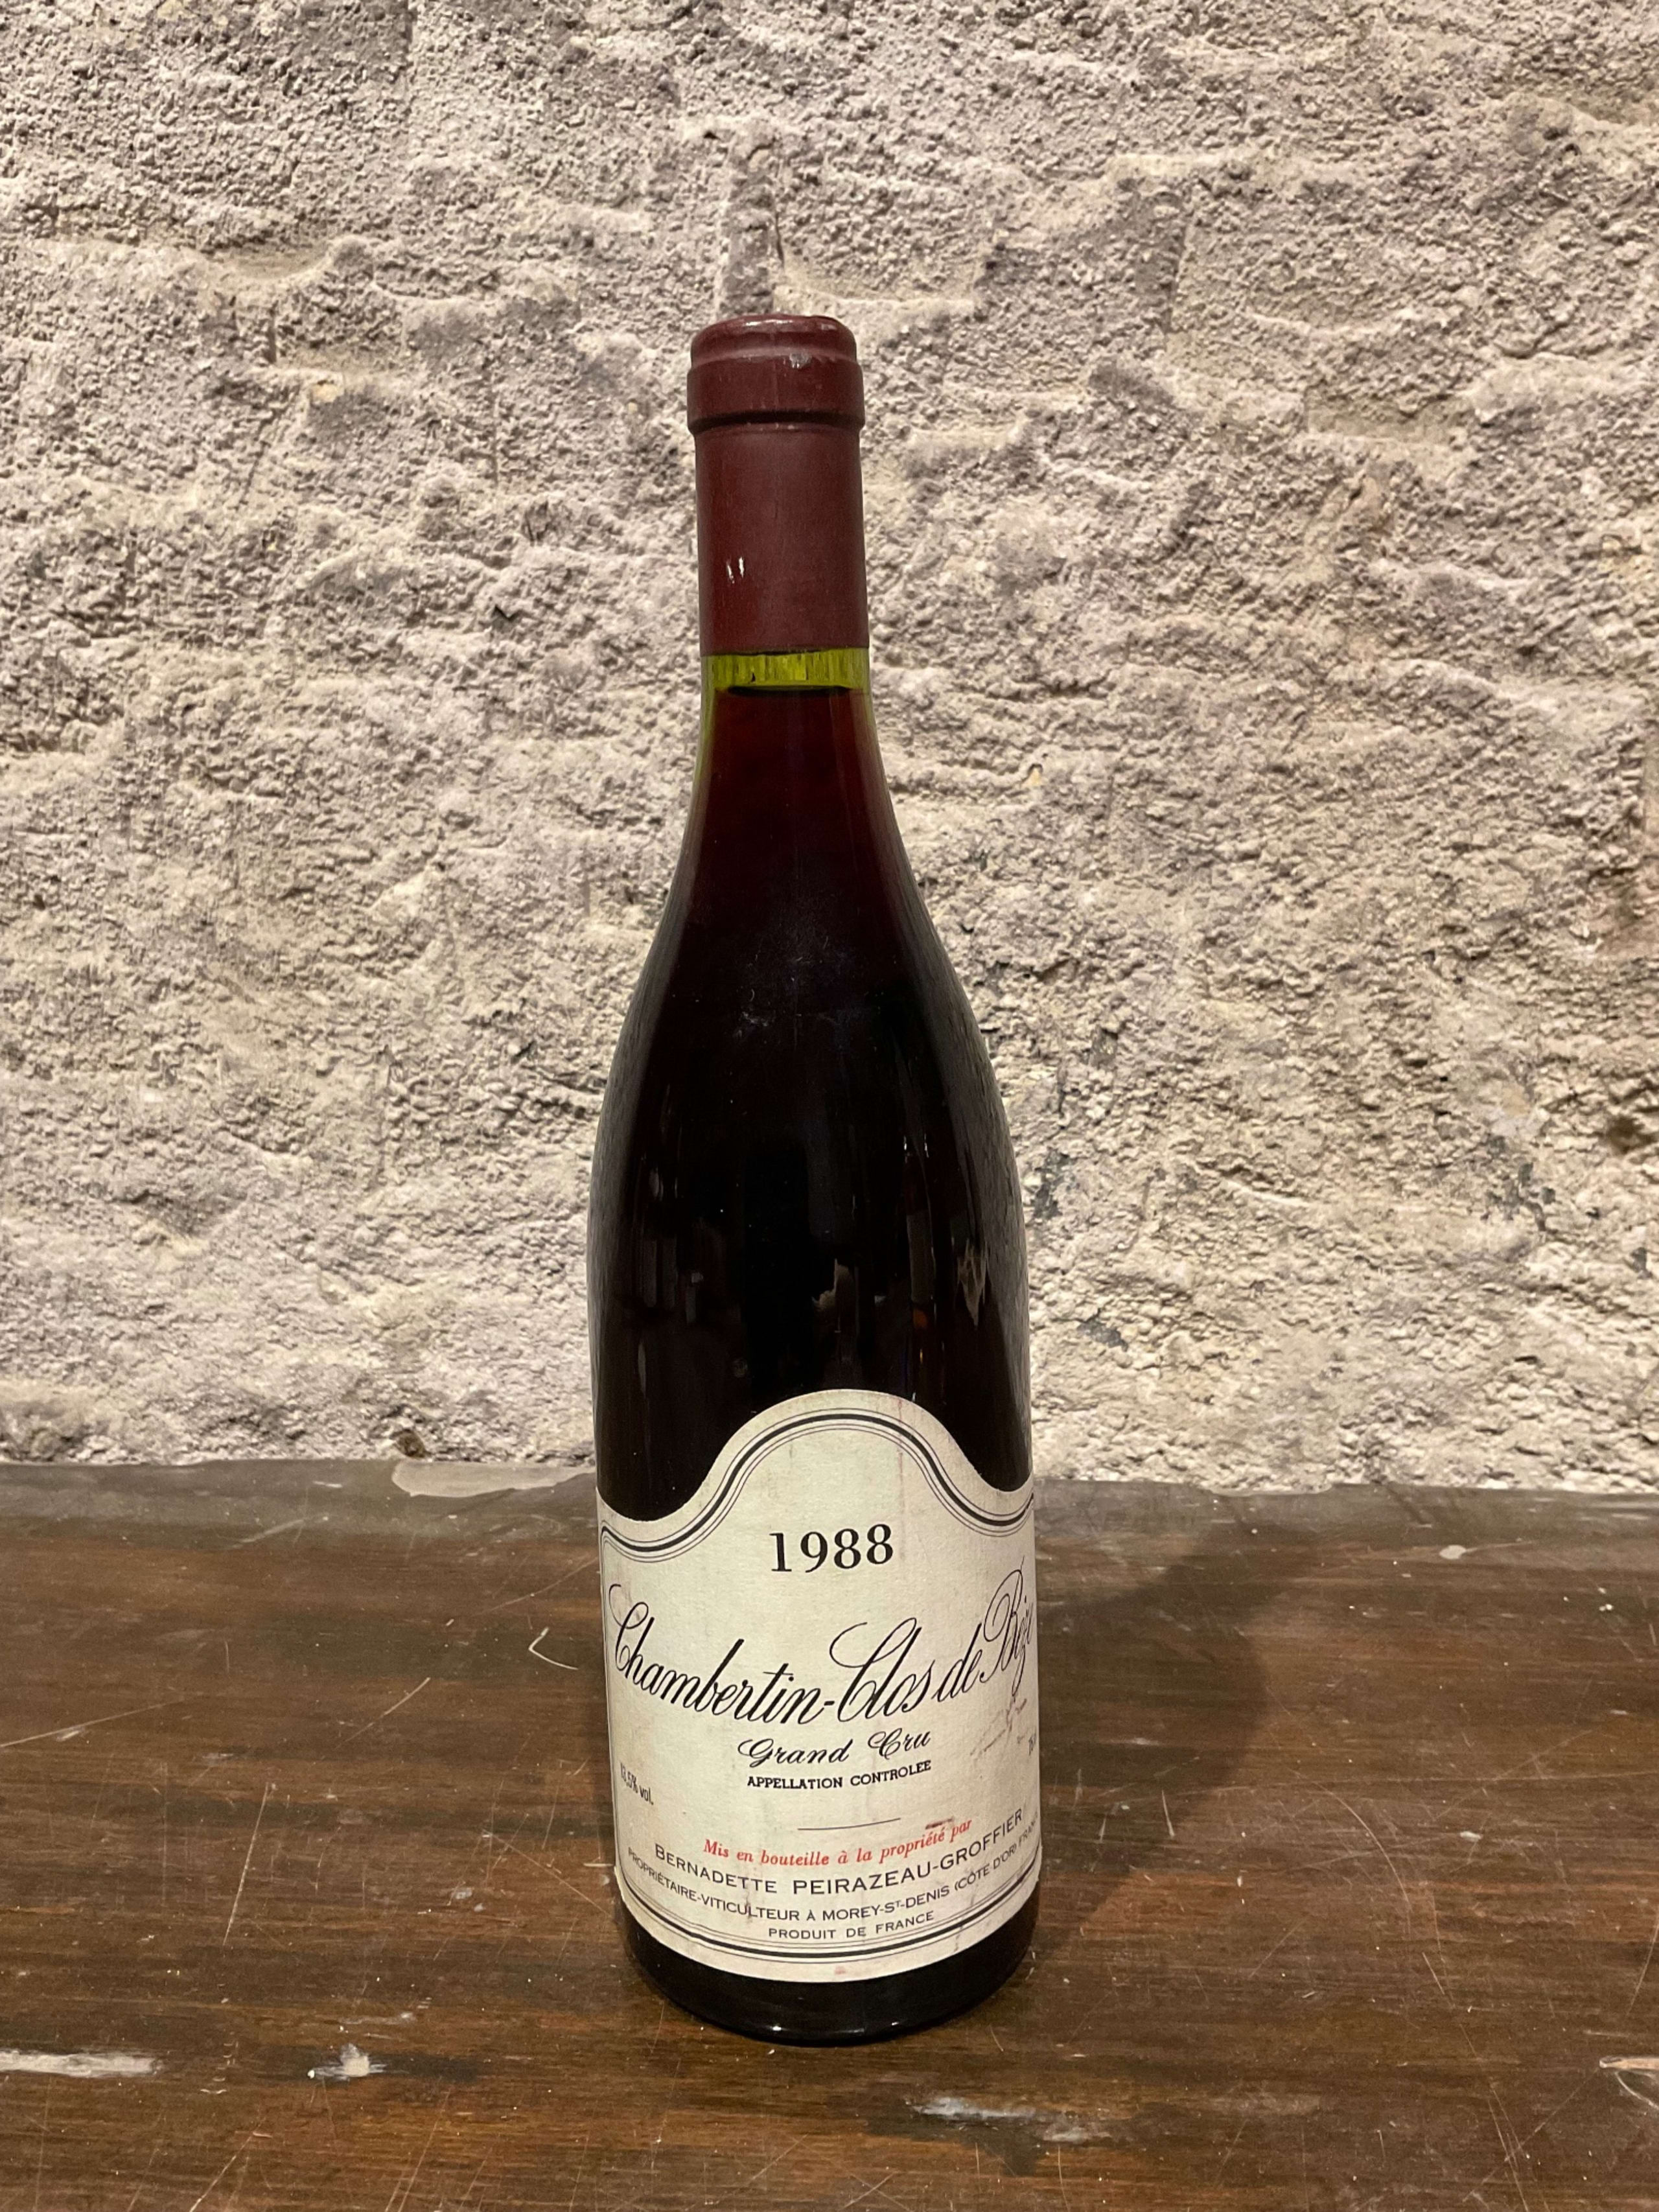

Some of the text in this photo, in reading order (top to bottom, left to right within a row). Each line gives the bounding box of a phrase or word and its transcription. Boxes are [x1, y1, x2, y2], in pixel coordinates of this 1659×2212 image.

[769, 1524, 894, 1573] 1988
[931, 1622, 983, 1703] de
[737, 1727, 931, 1768] Grand Cru
[747, 1760, 932, 1789] APPELLATION CONTROLEE
[655, 1808, 1022, 1895] BERNADETTE PEIRAZEAU-GROFFIER
[703, 1819, 973, 1867] Mis en bouteille à la propriété par
[769, 1910, 935, 1940] PRODUIT DE FRANCE
[806, 1908, 817, 1921] À
